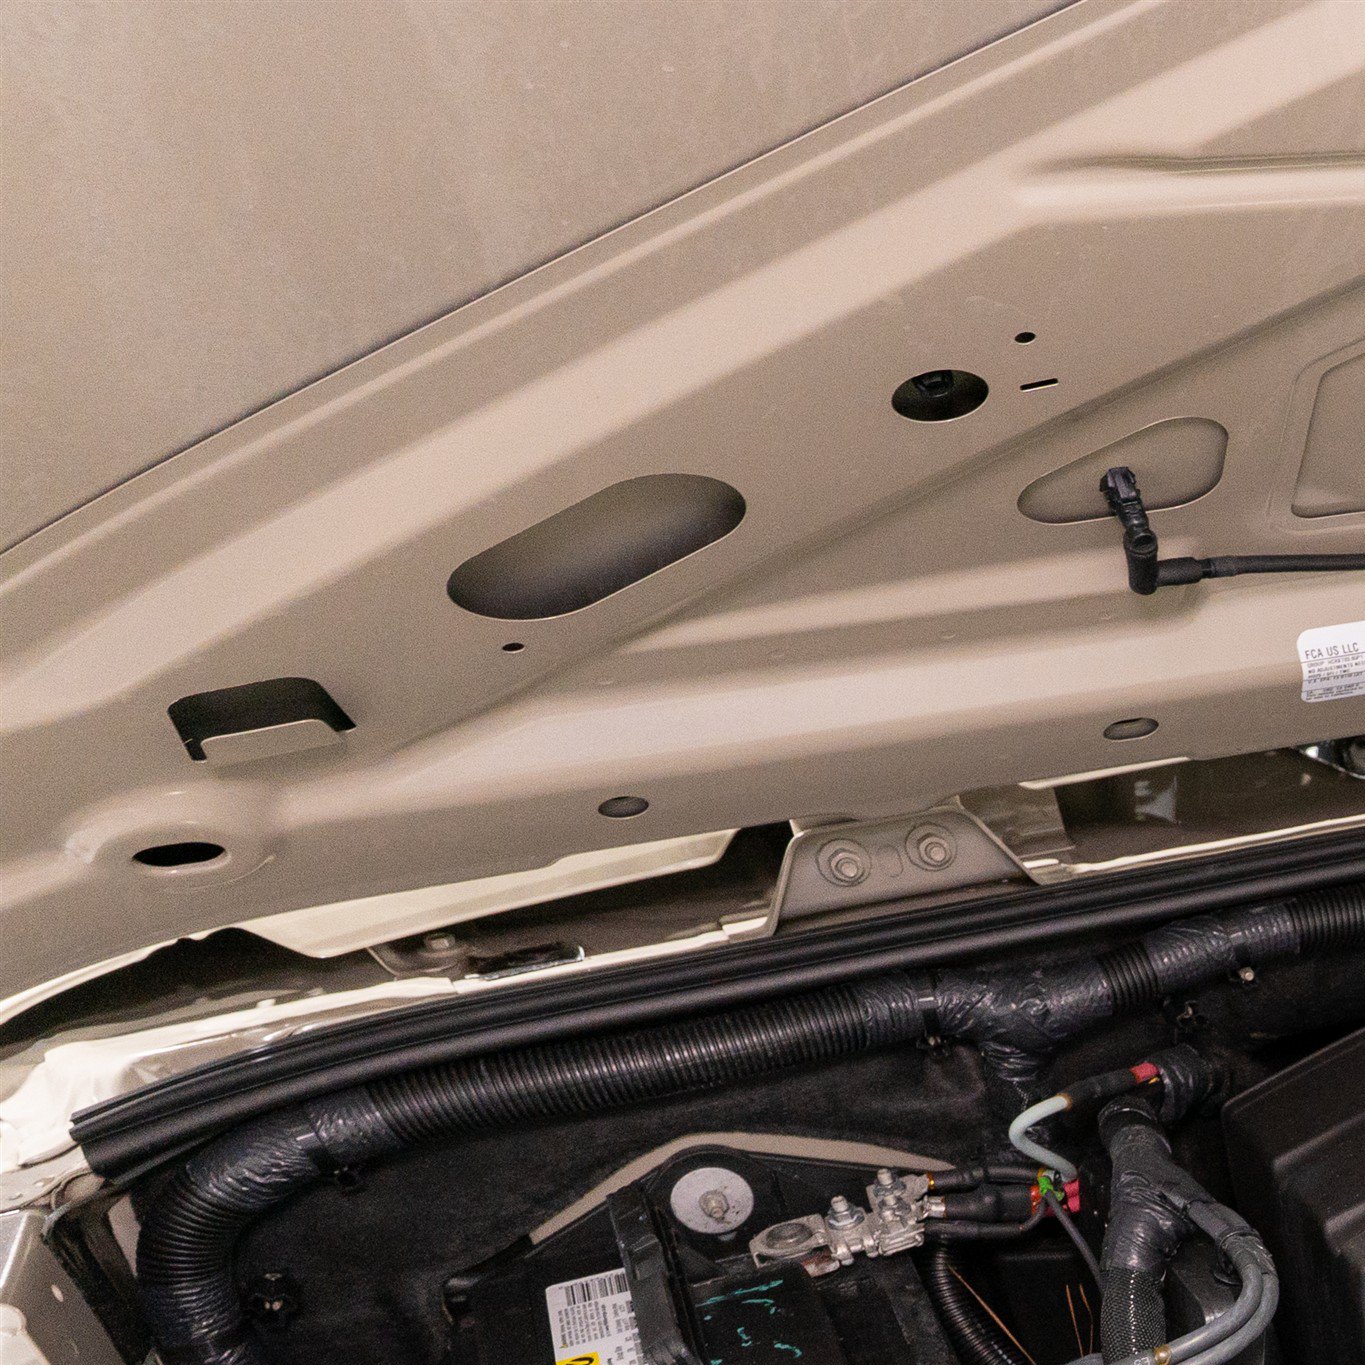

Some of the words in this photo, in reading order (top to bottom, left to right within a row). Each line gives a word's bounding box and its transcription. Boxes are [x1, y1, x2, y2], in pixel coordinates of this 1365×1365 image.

[1304, 648, 1323, 660] FCA
[1325, 645, 1339, 657] US
[1341, 642, 1359, 654] LLC
